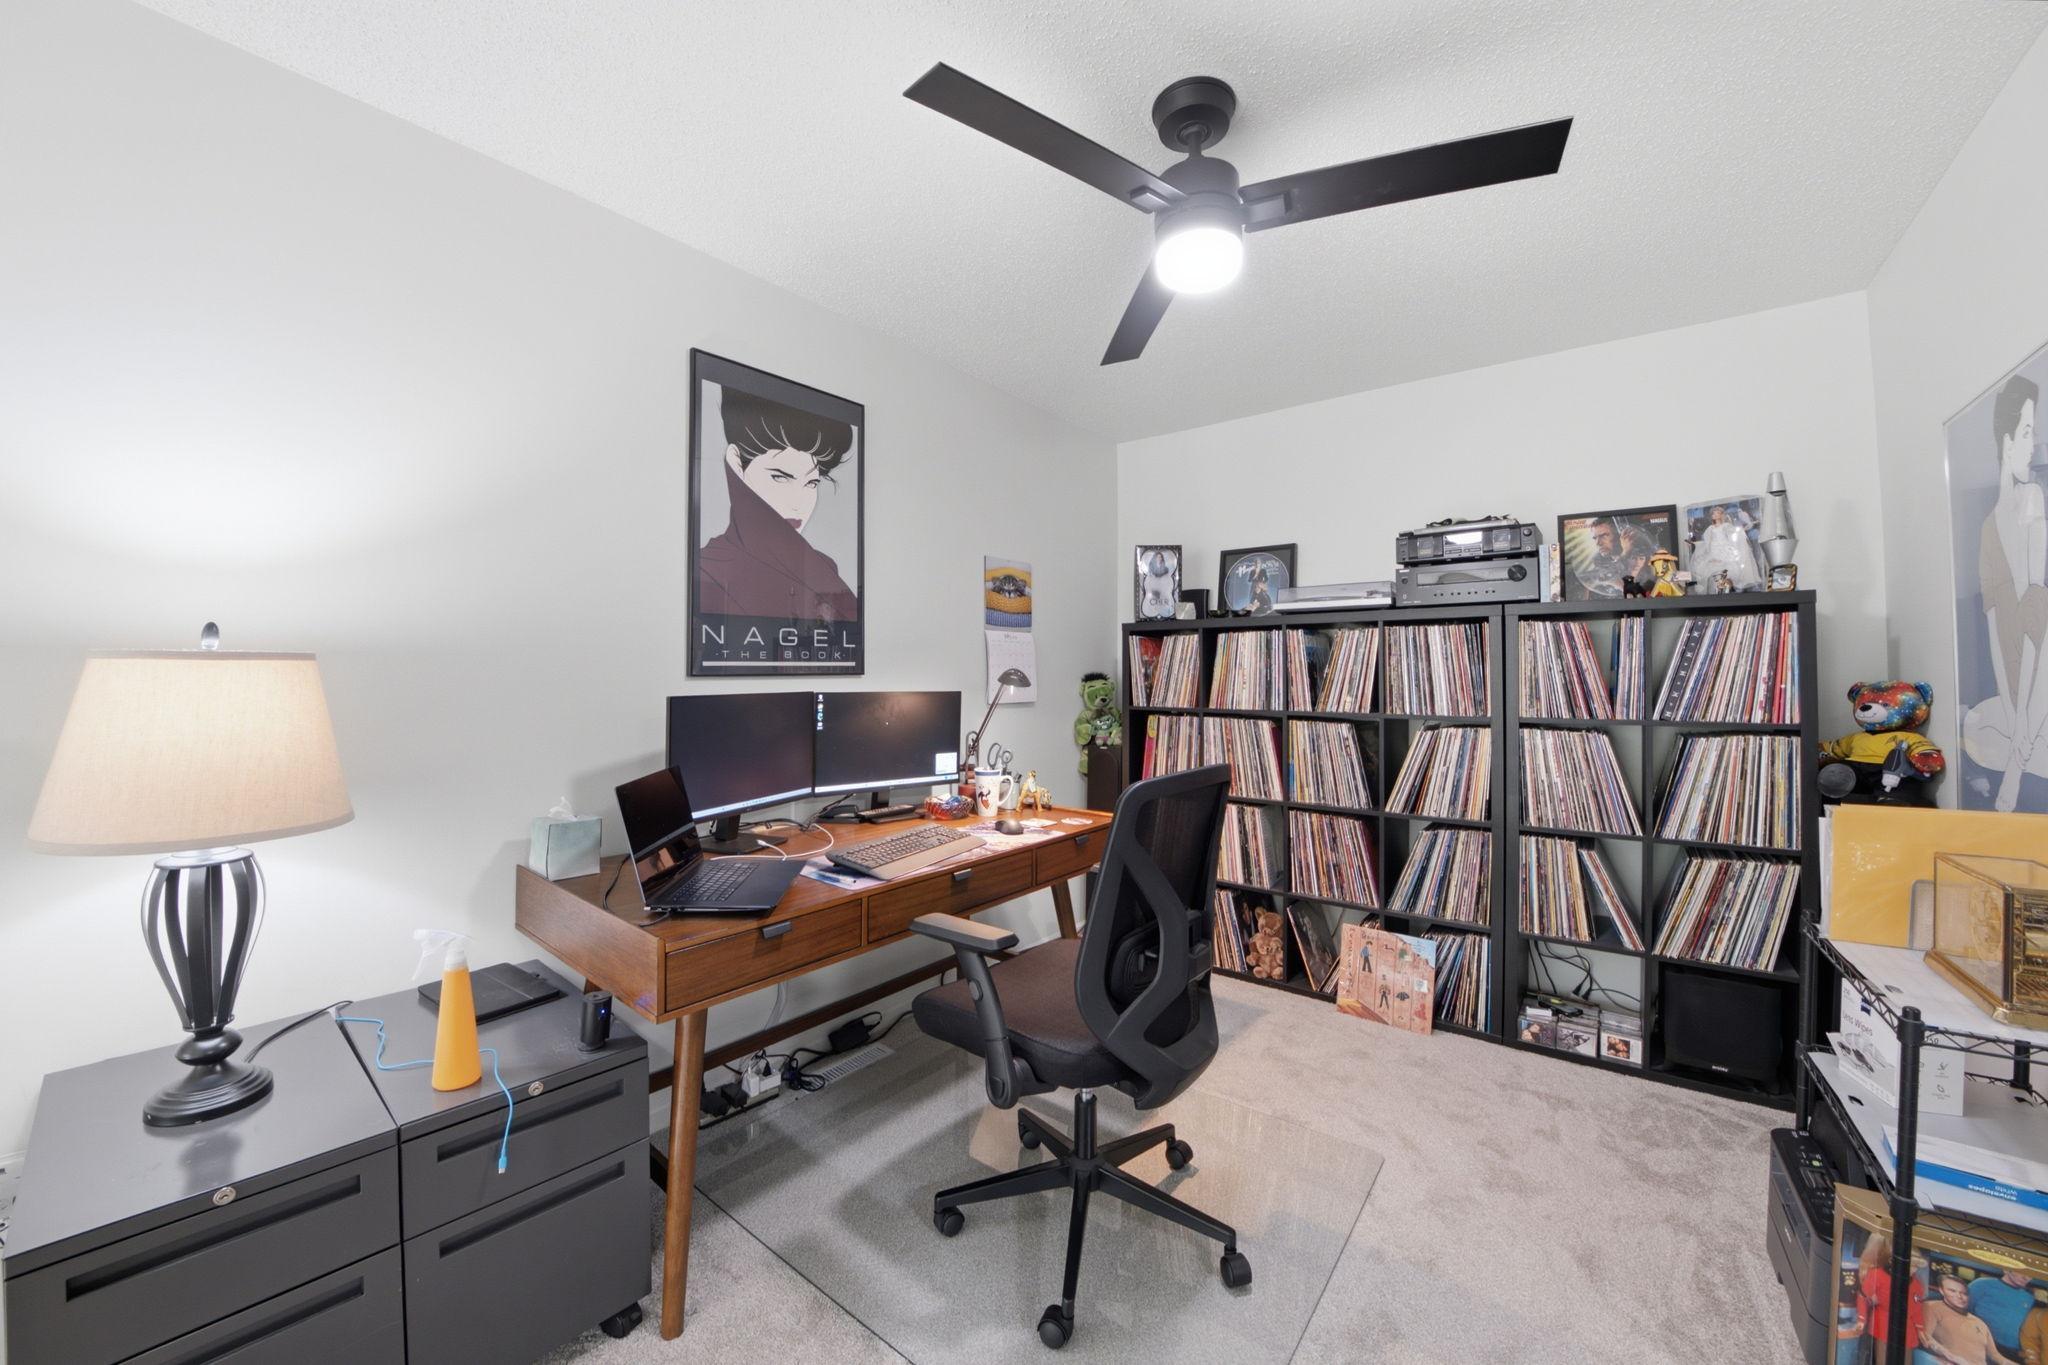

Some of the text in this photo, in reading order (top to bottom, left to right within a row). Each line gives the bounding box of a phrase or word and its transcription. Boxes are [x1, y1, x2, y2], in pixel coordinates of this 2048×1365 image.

[702, 624, 856, 648] NAGEL
[721, 650, 841, 660] THE BOOK
